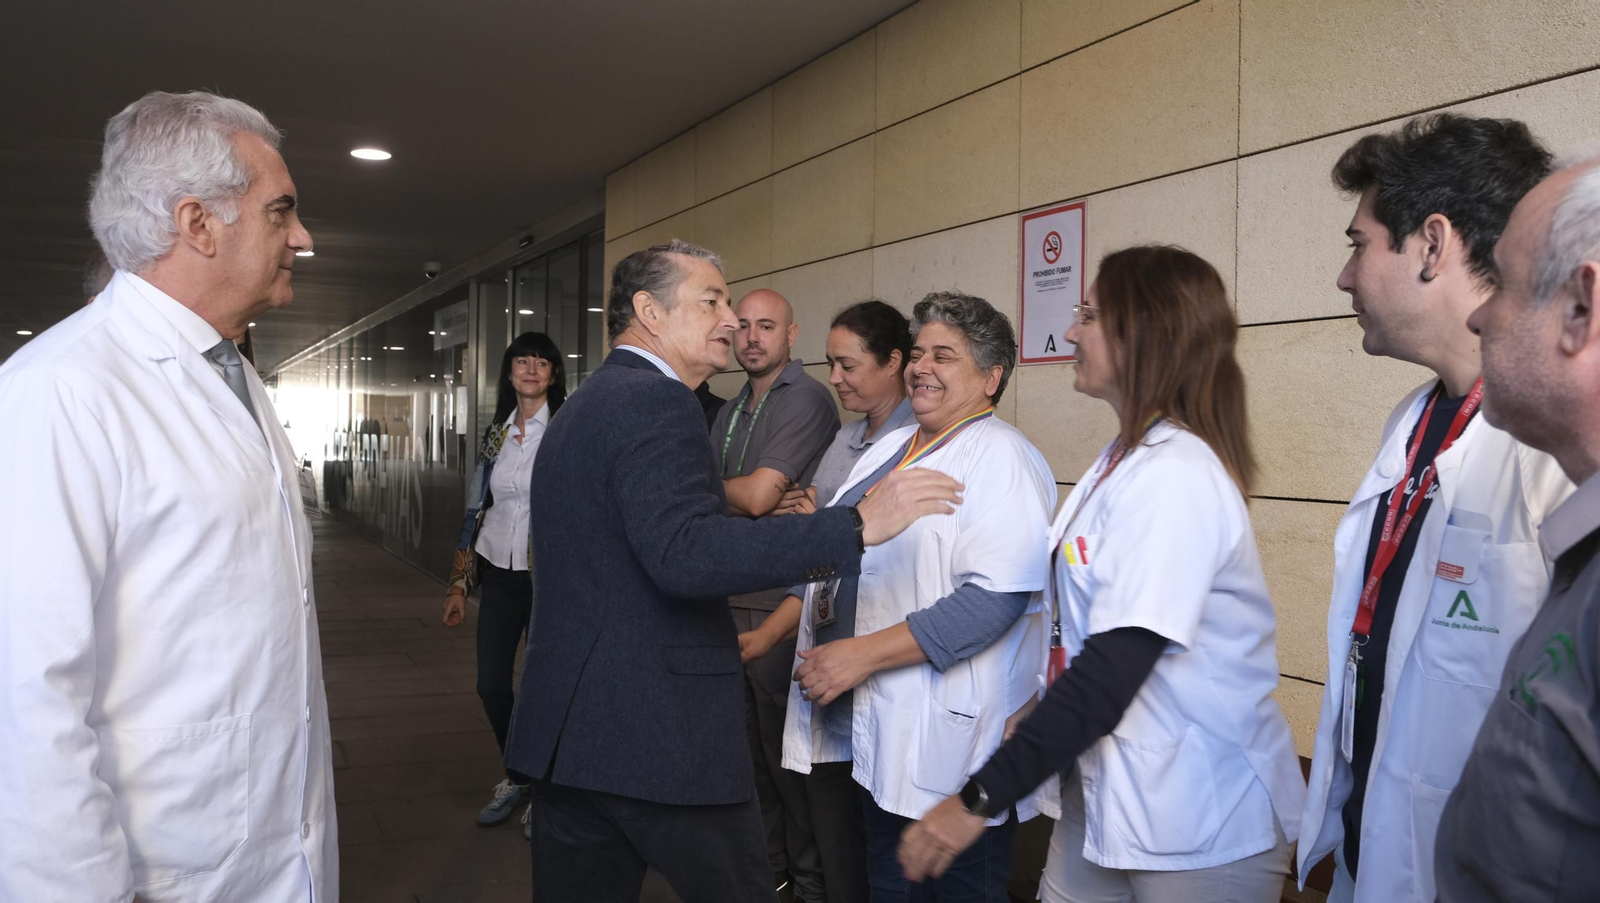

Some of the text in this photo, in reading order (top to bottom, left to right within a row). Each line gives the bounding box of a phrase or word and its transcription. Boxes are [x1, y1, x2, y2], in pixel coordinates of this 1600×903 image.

[1033, 266, 1072, 278] PROHIBIDO FUMAR
[1431, 618, 1449, 627] Junta
